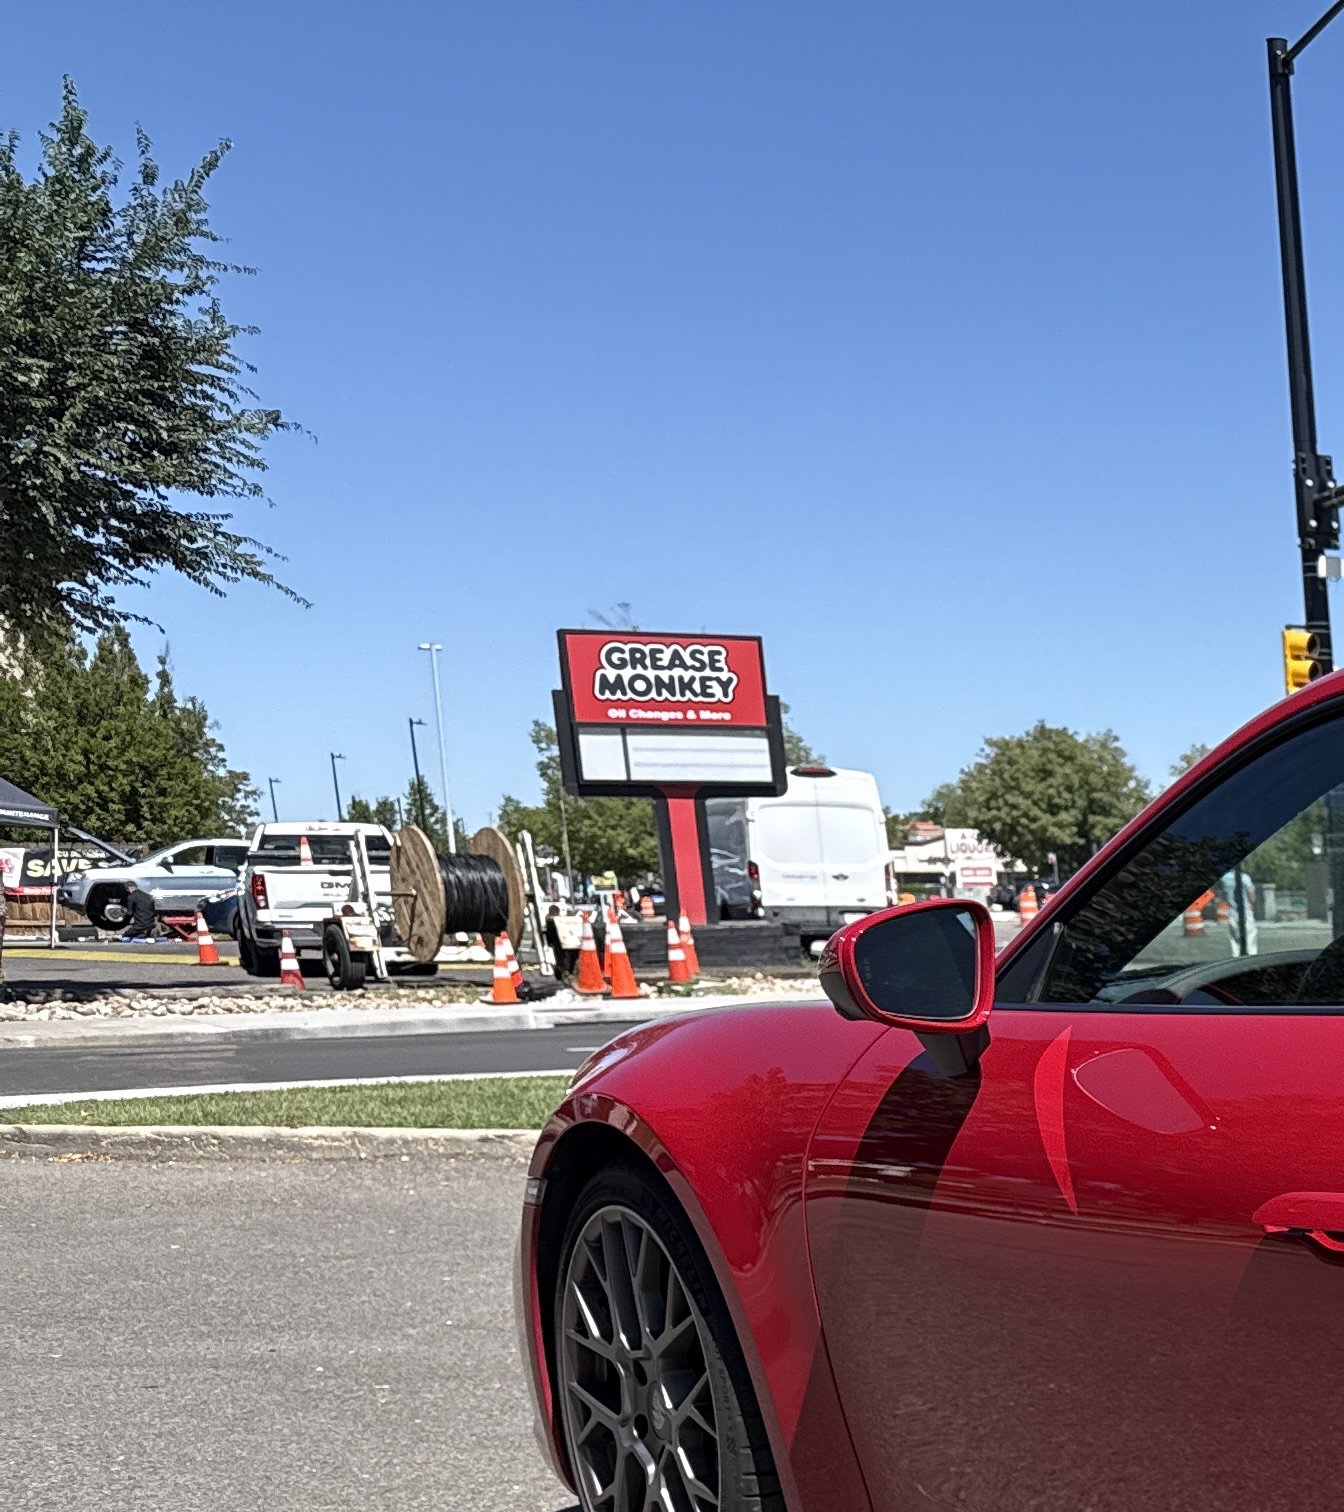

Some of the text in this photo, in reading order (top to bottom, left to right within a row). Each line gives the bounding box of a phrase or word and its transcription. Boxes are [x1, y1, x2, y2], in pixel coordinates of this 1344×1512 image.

[604, 646, 725, 672] GREASE
[598, 672, 734, 699] MONKEY
[607, 708, 732, 721] Oil Changes & More
